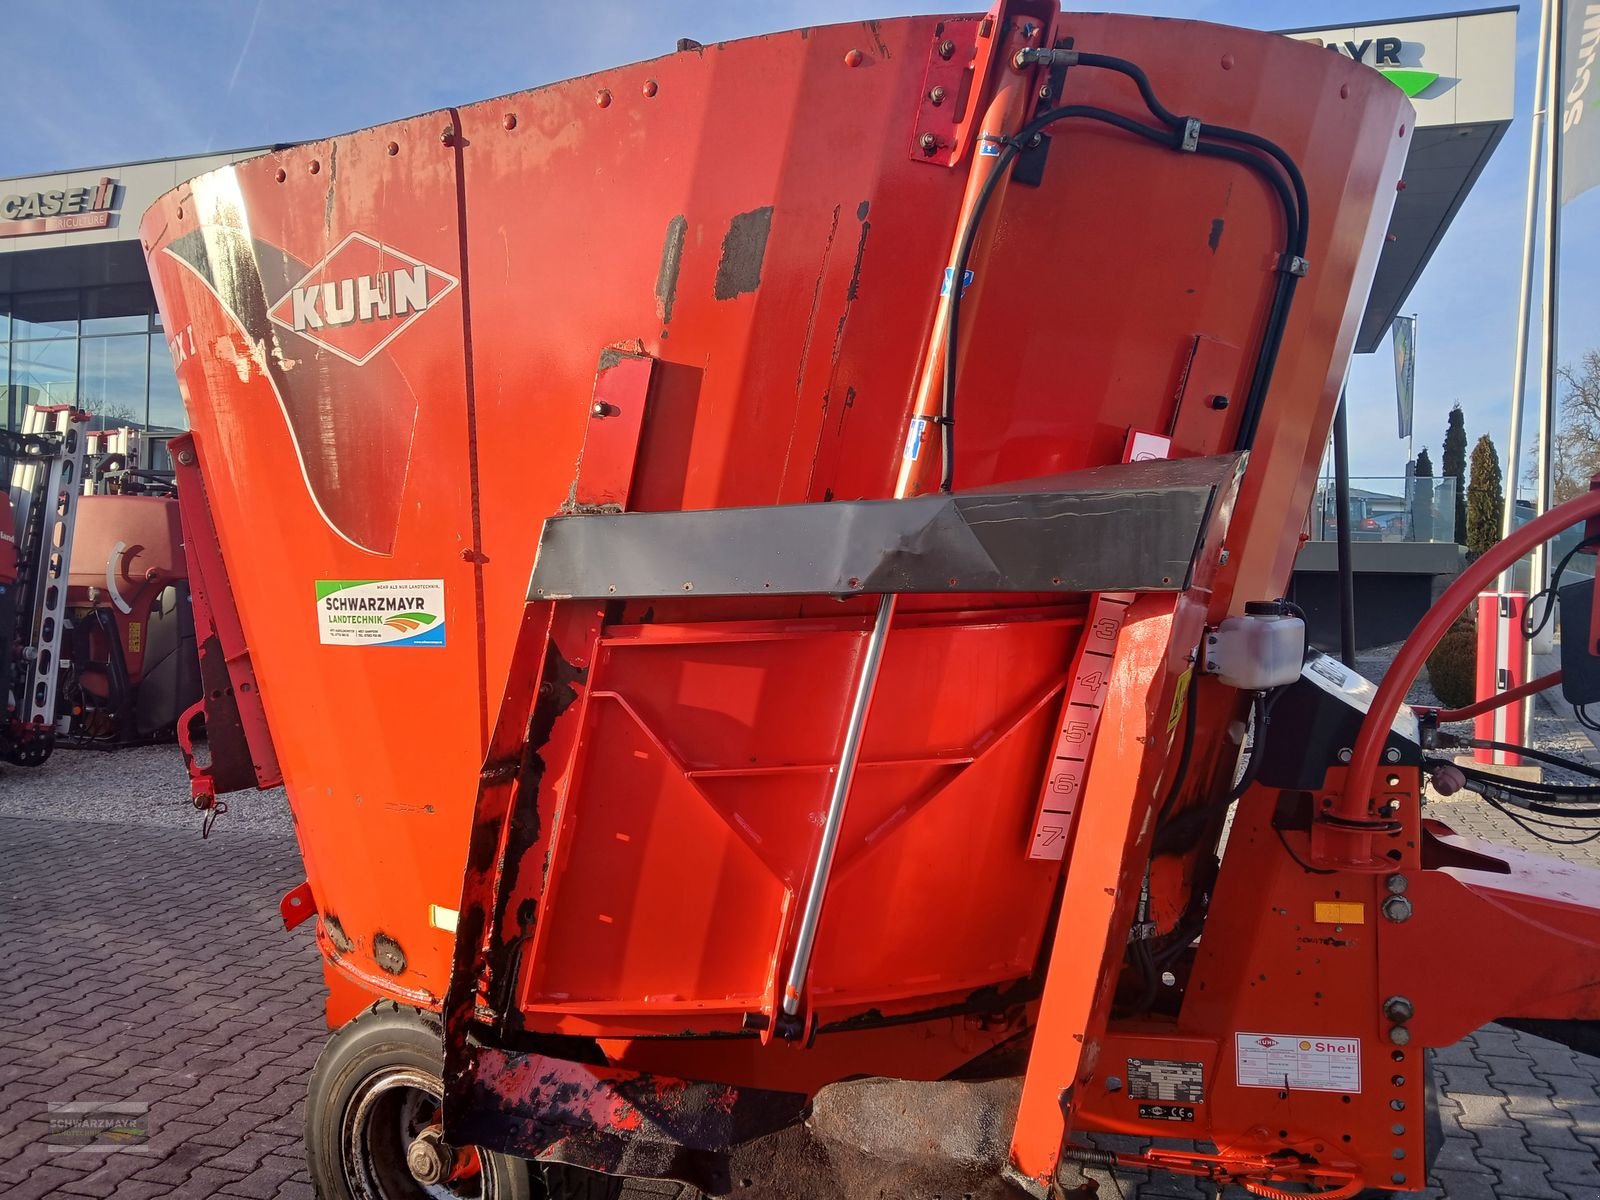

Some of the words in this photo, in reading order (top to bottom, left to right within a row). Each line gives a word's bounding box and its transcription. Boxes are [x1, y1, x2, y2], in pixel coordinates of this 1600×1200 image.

[0, 187, 87, 220] CASE
[47, 214, 105, 229] RICULTURE
[292, 264, 428, 332] KUHN
[326, 597, 425, 611] SCHWARZMAYR
[328, 615, 383, 625] LANDTECHNIK
[1095, 618, 1120, 641] 3
[1080, 671, 1103, 692] 4
[1065, 720, 1089, 744] 5
[1052, 773, 1076, 795] 6
[1041, 825, 1064, 847] 7
[1315, 1042, 1356, 1054] Shell
[1171, 1107, 1185, 1117] CE
